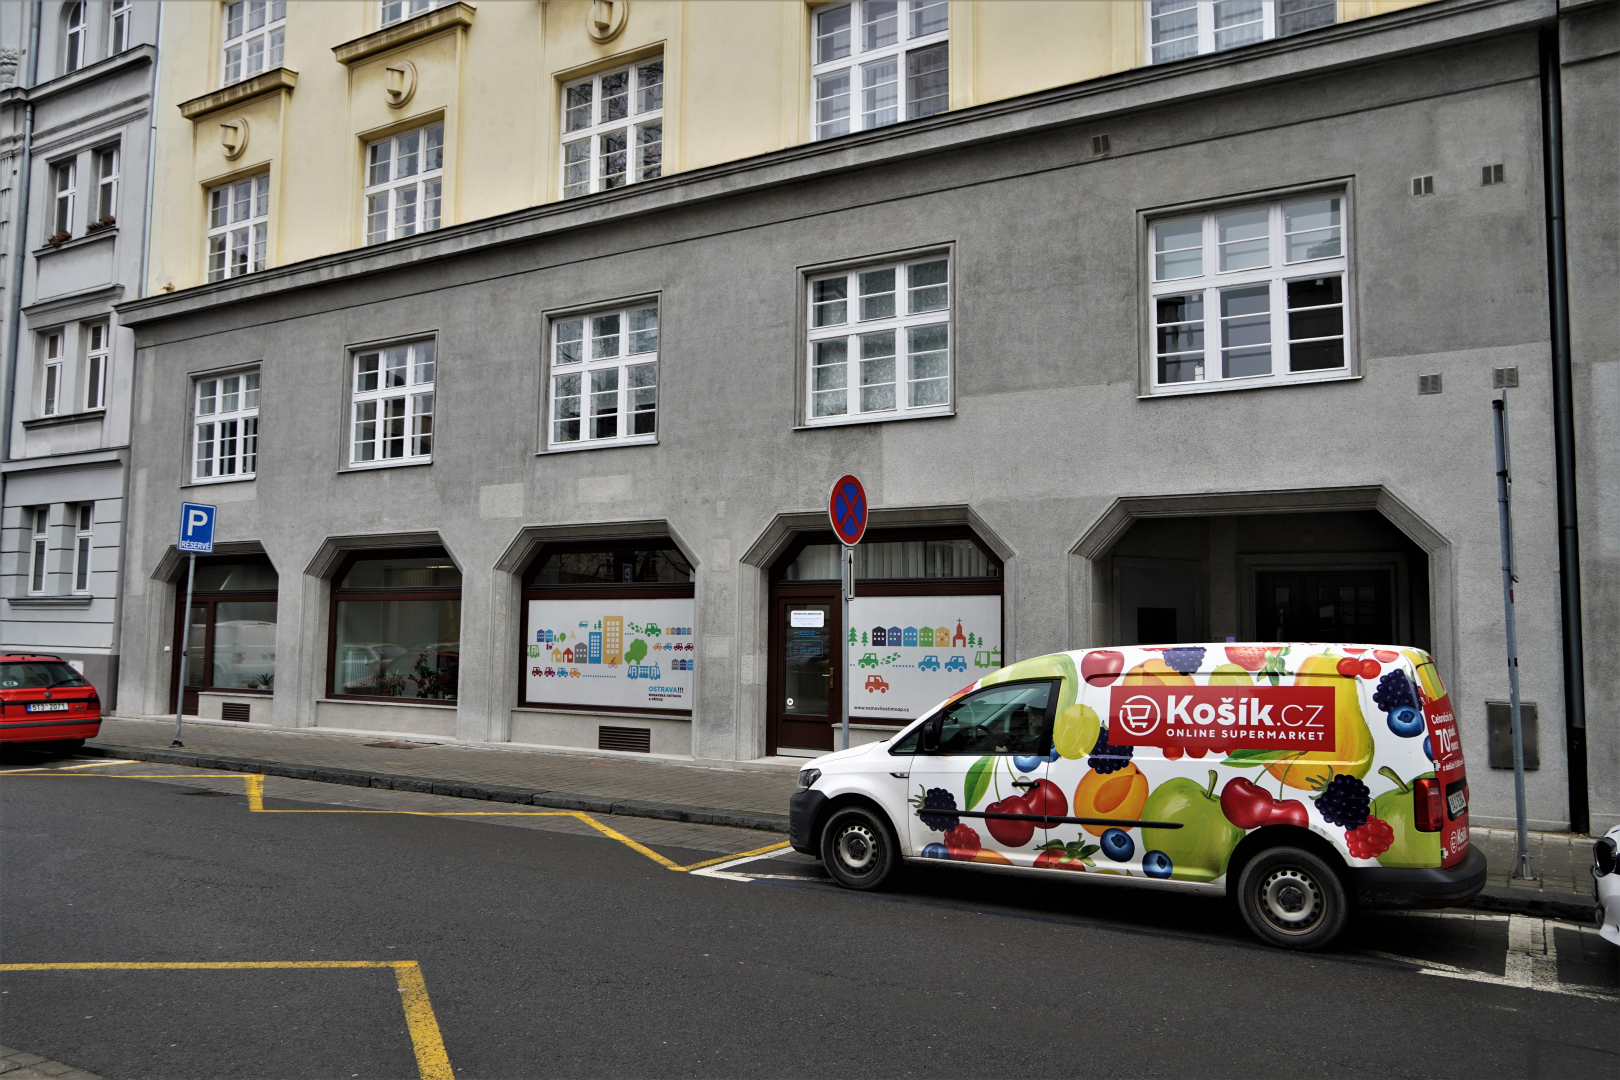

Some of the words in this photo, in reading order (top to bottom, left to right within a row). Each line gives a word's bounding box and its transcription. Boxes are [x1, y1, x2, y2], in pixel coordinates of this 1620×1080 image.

[187, 509, 208, 536] P
[1166, 728, 1216, 738] ONLINE
[1221, 729, 1325, 741] SUPERMARKET
[1434, 728, 1451, 754] 70
